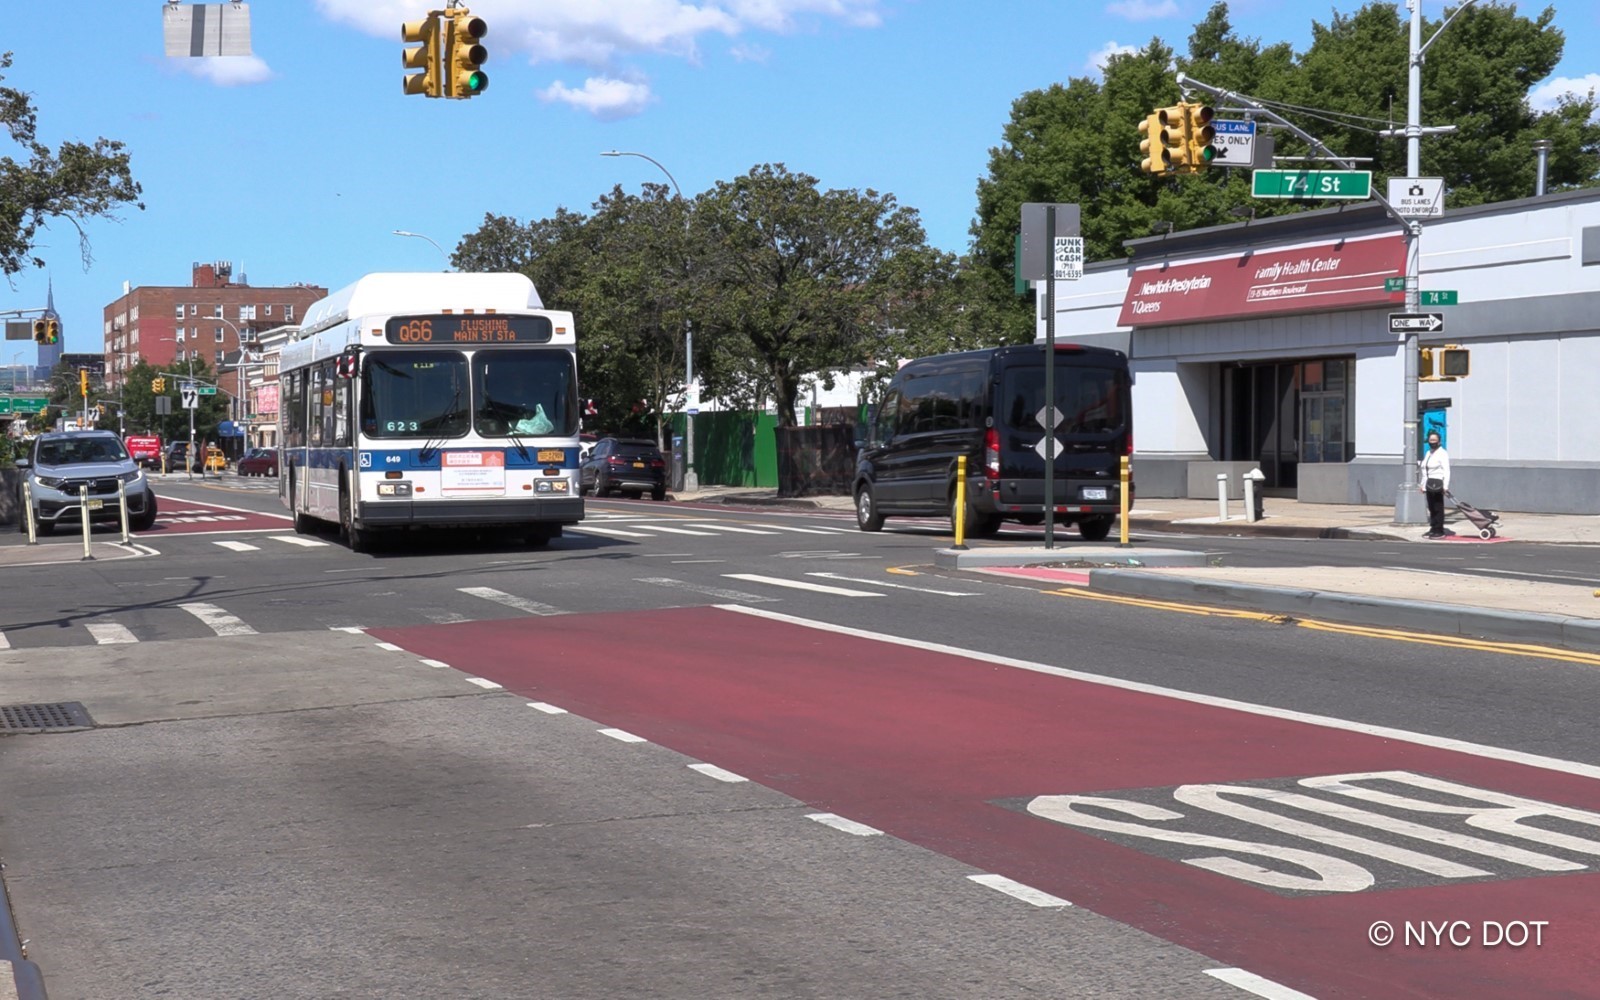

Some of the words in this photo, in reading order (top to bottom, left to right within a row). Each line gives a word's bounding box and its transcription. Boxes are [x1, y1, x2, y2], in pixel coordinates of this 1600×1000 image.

[1229, 124, 1250, 132] LANE
[1228, 136, 1251, 145] ONLY
[1284, 176, 1309, 192] 74
[1321, 176, 1341, 192] St
[1283, 258, 1311, 276] Health
[1311, 257, 1341, 272] Center
[1282, 284, 1308, 295] Boulevard
[1429, 292, 1439, 304] 74
[1393, 319, 1410, 327] ONE
[400, 320, 432, 342] Q66
[461, 319, 509, 331] FLUSHING
[454, 331, 478, 341] MAIN
[482, 331, 494, 341] ST
[498, 331, 516, 341] STA
